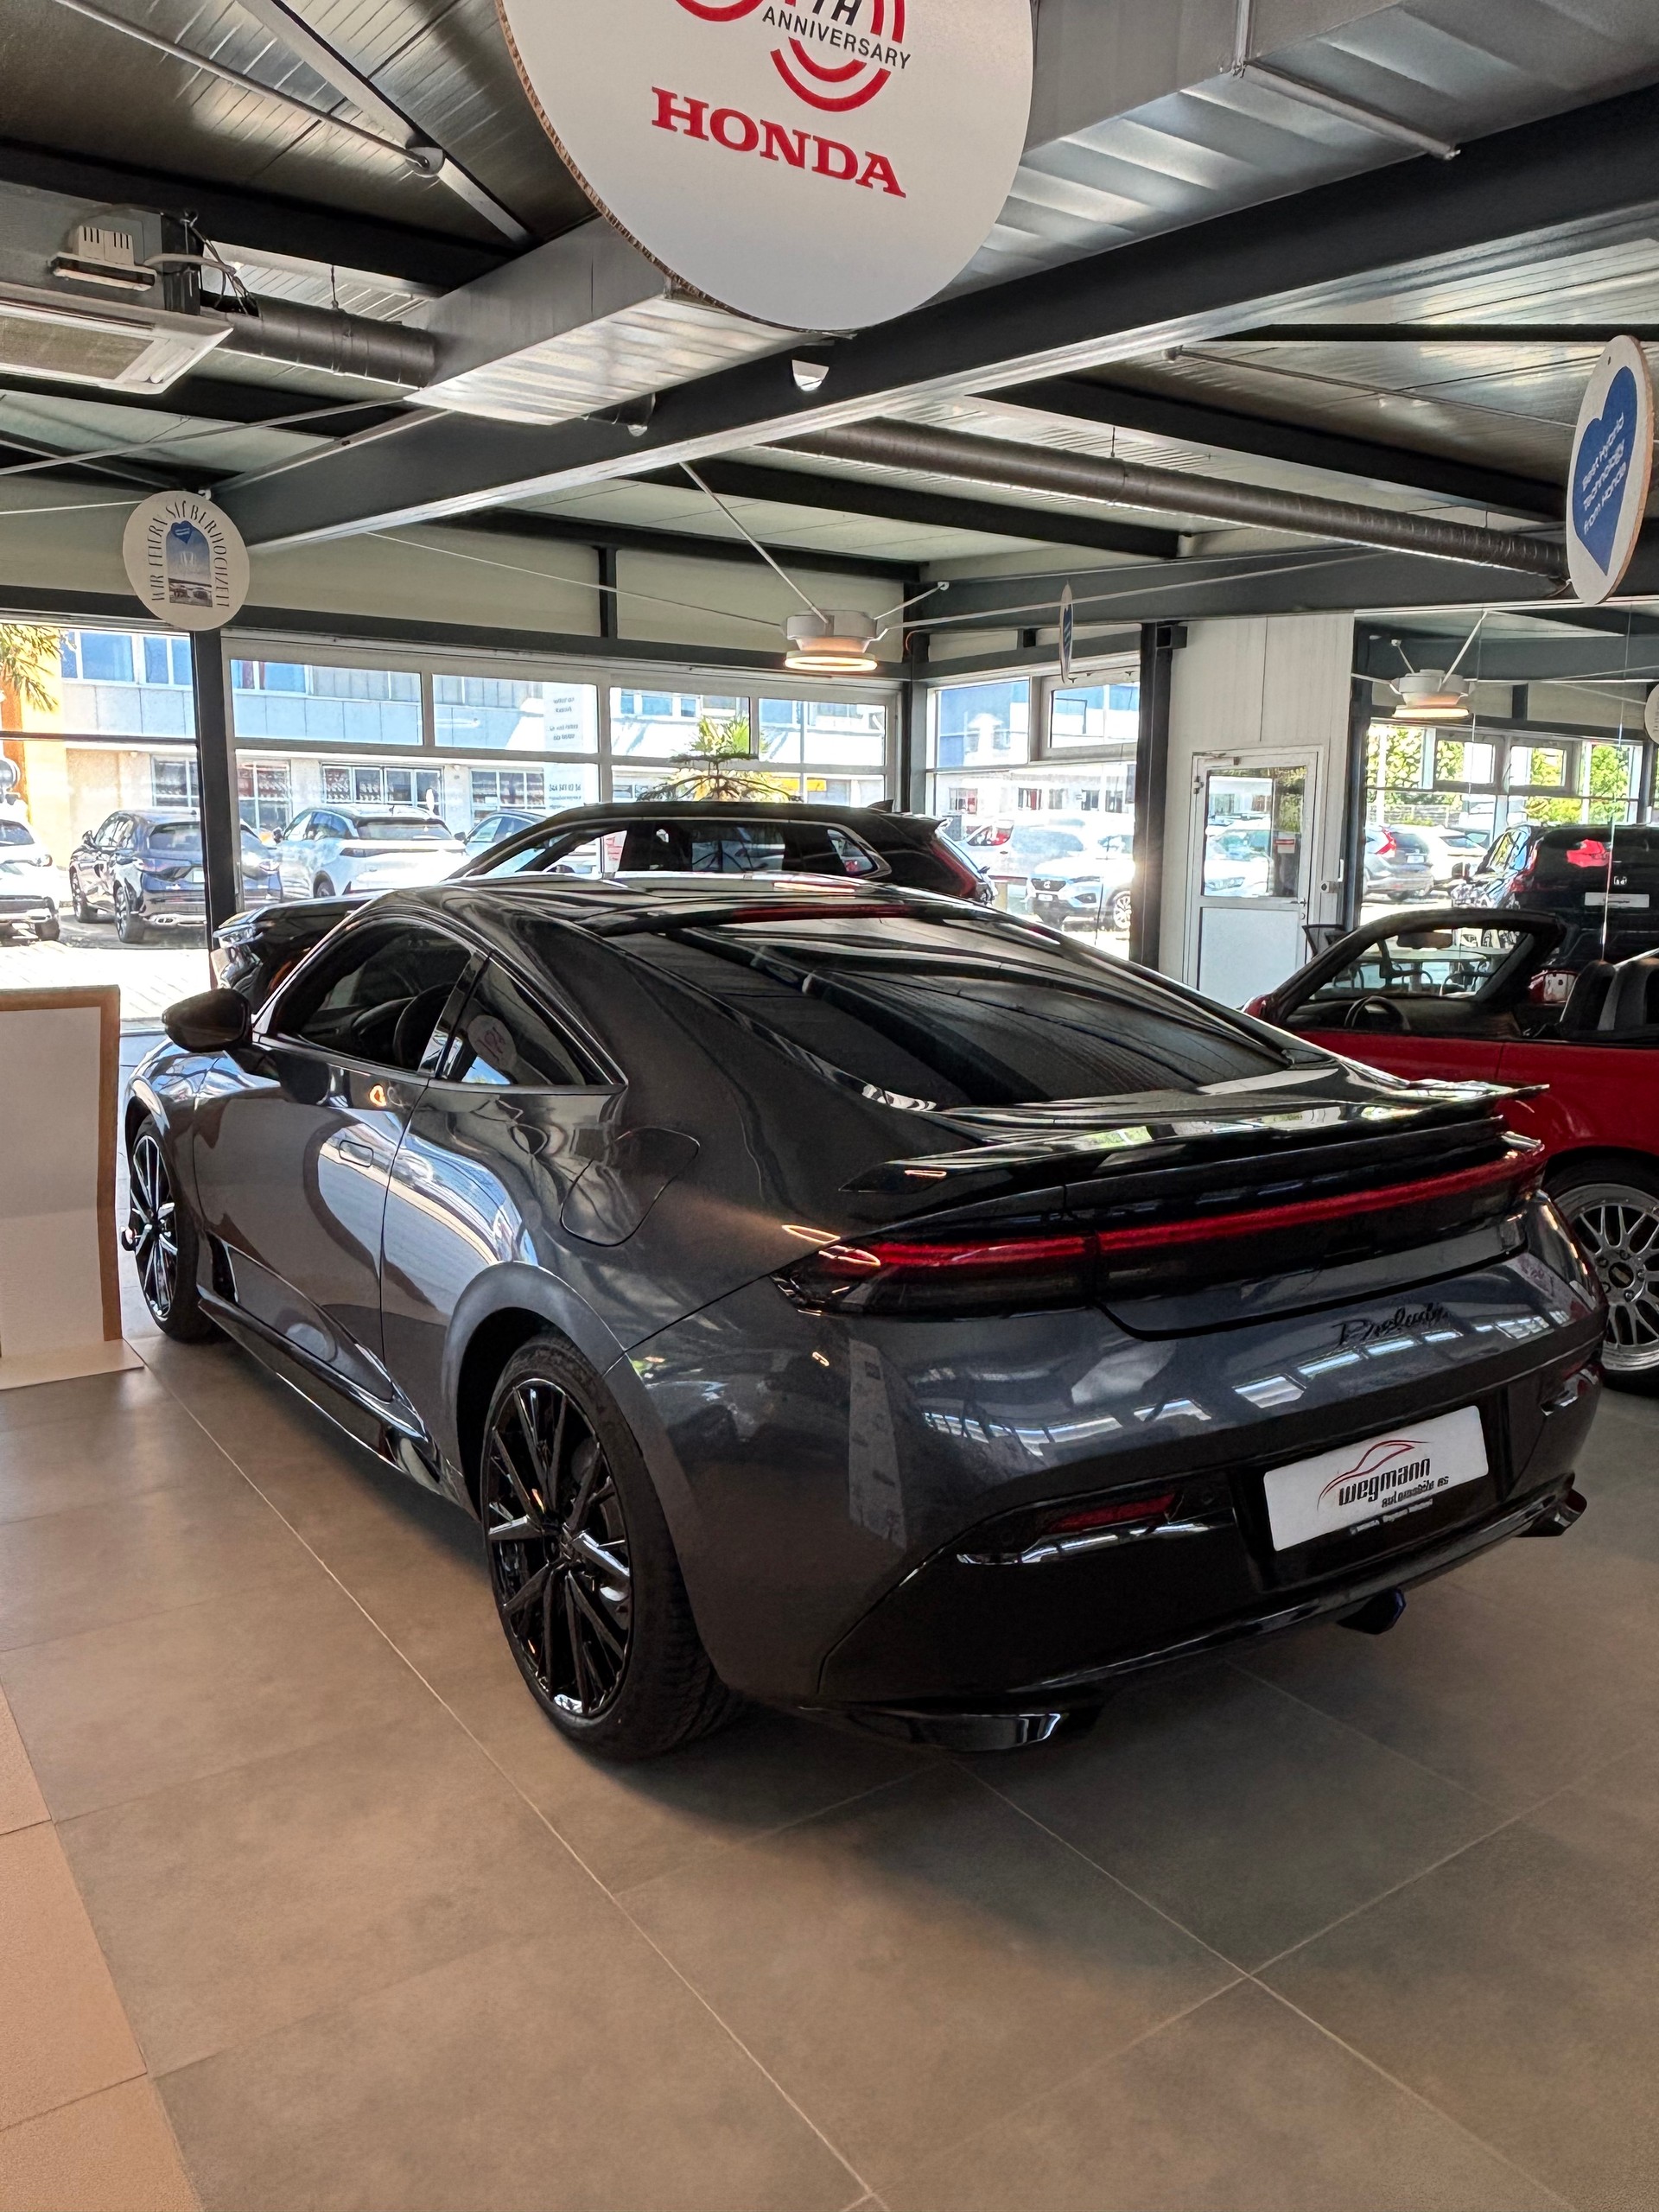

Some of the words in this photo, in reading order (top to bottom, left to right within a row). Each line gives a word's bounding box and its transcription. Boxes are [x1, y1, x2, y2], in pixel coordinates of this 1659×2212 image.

[762, 5, 912, 70] ANNIVERSARY
[651, 86, 906, 199] HONDA
[1601, 461, 1626, 507] Honda
[1338, 1458, 1431, 1506] wegmann
